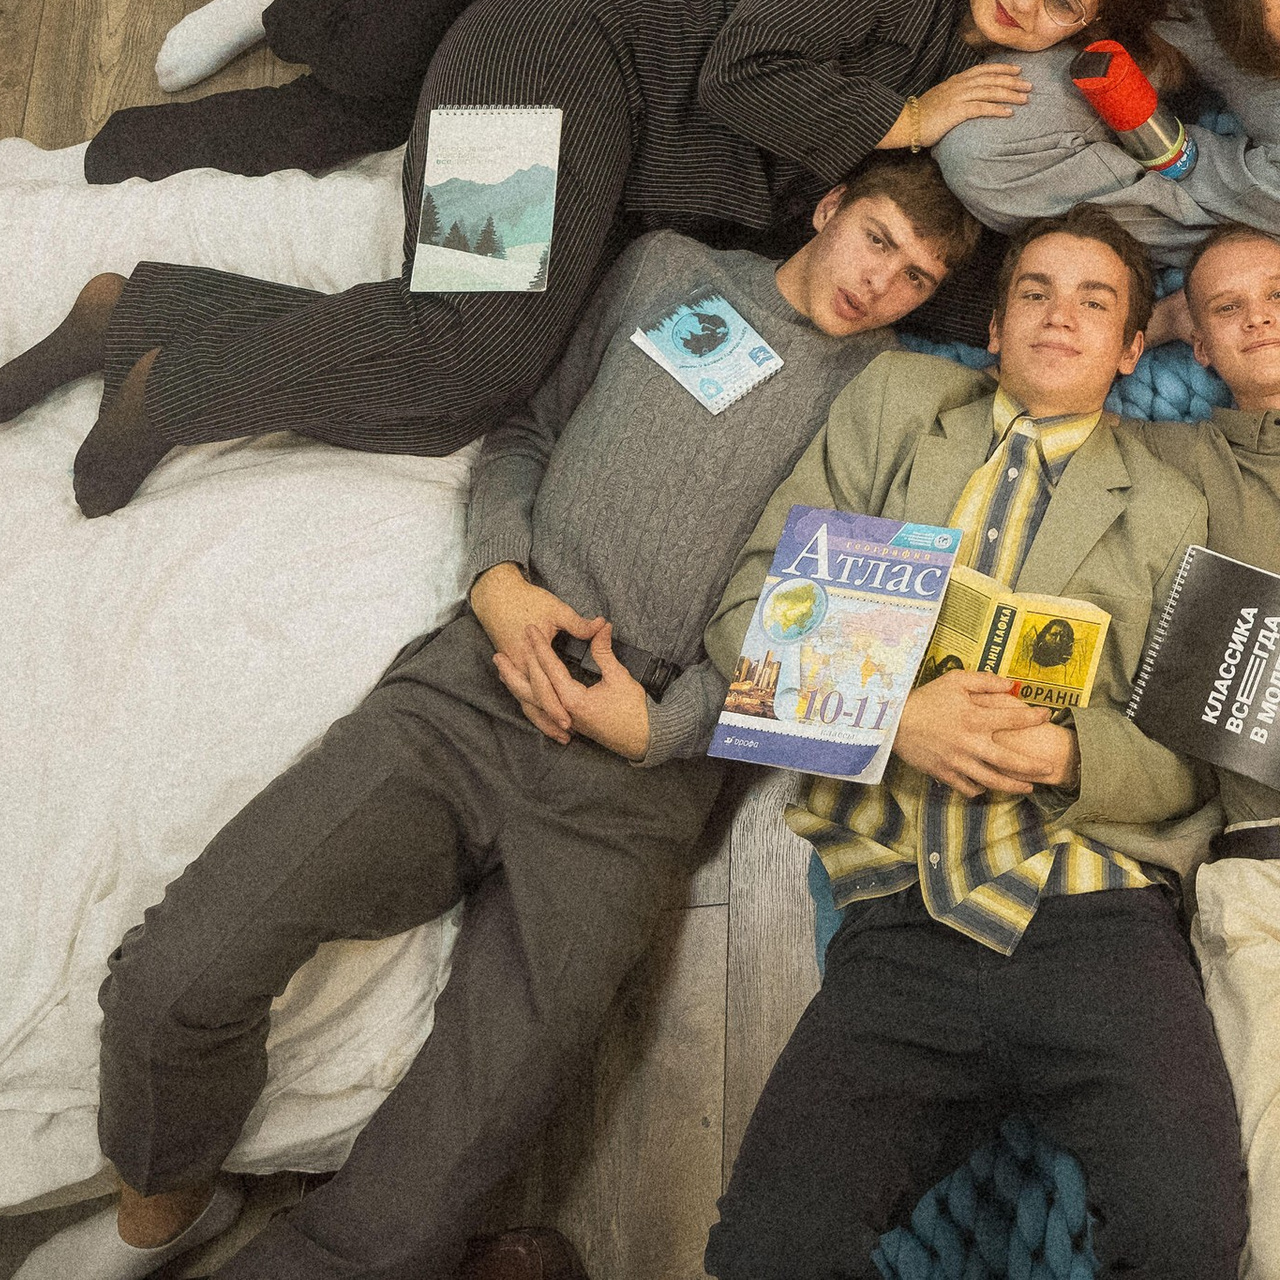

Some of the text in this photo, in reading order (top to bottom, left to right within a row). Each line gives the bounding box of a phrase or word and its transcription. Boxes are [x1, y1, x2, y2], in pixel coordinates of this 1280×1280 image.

[782, 523, 942, 596] Атлас
[846, 541, 932, 562] география
[984, 608, 1012, 673] РАНЦ КАФКА
[1201, 607, 1259, 725] КЛАССИКА
[802, 688, 890, 731] 10-11
[1020, 684, 1080, 707] ФРАНЦ
[1250, 726, 1268, 745] В
